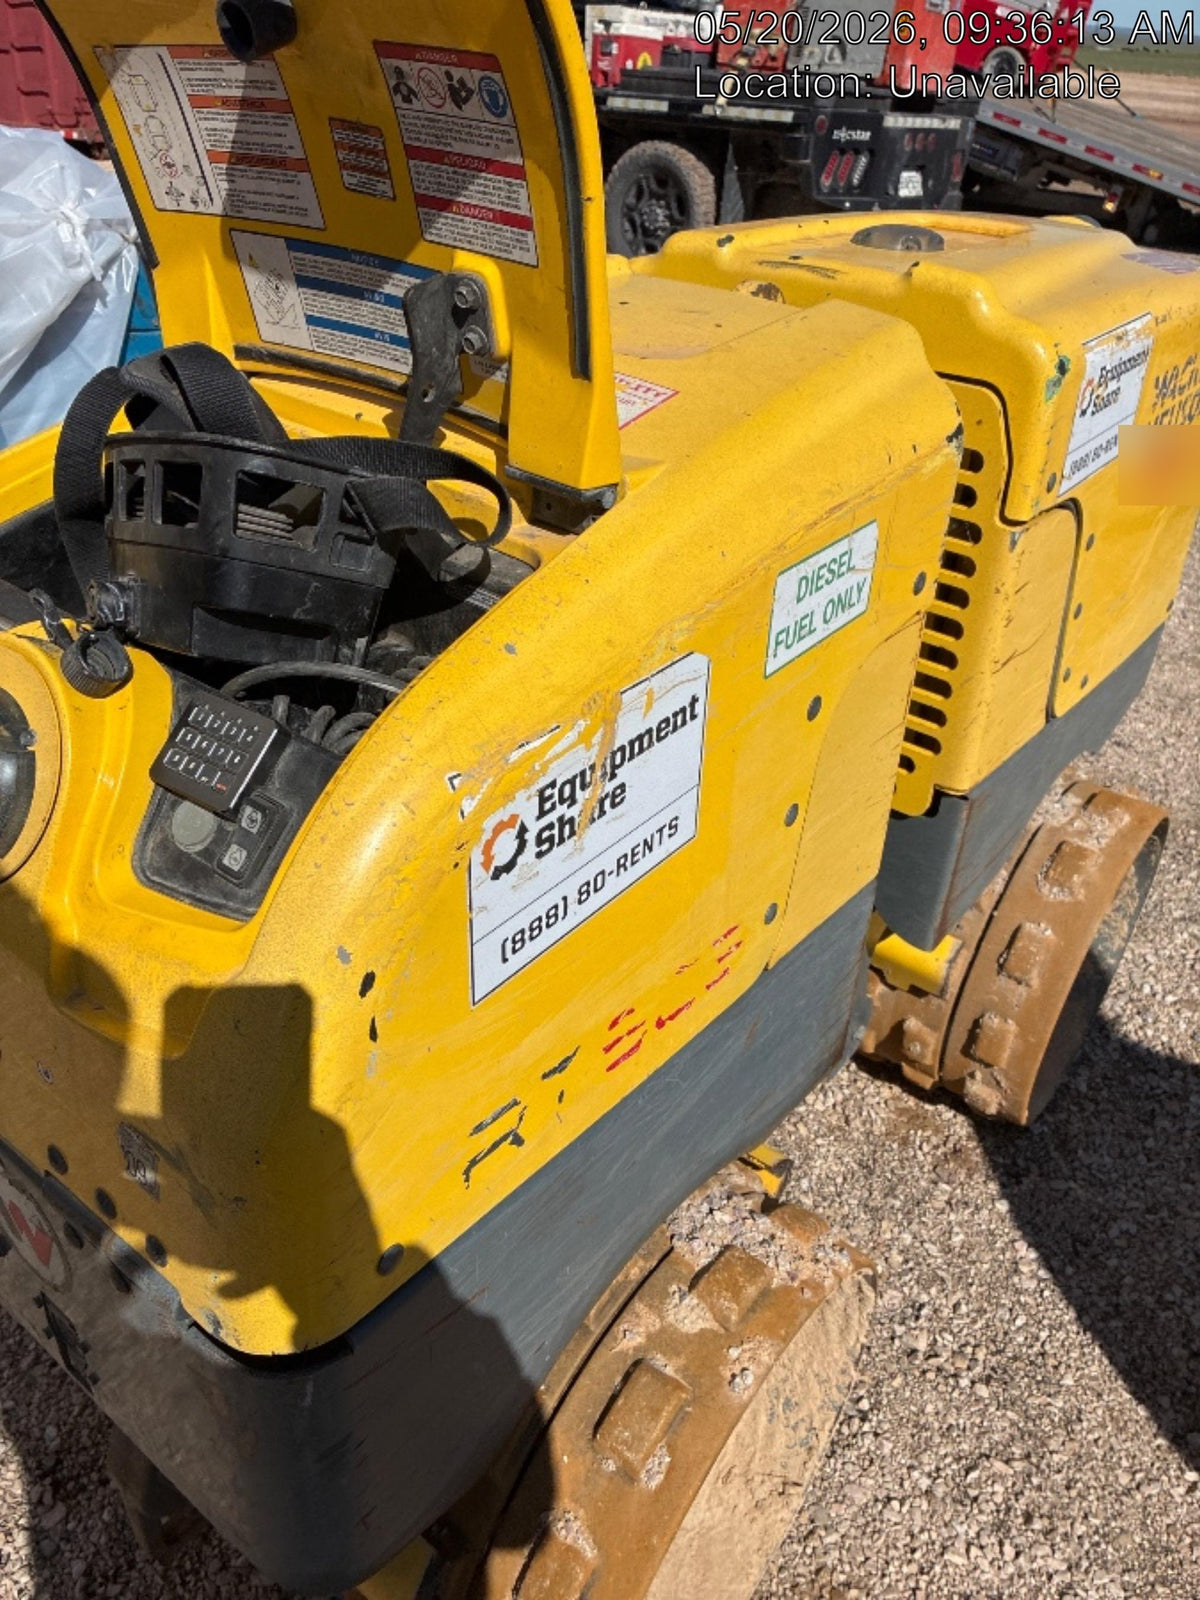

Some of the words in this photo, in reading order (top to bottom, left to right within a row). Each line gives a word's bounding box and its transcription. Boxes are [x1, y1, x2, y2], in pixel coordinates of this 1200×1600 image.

[796, 548, 856, 605] DIESEL
[773, 610, 817, 659] FUEL
[823, 577, 867, 625] ONLY
[501, 895, 568, 964] (888)
[577, 815, 680, 906] 80-RENTS
